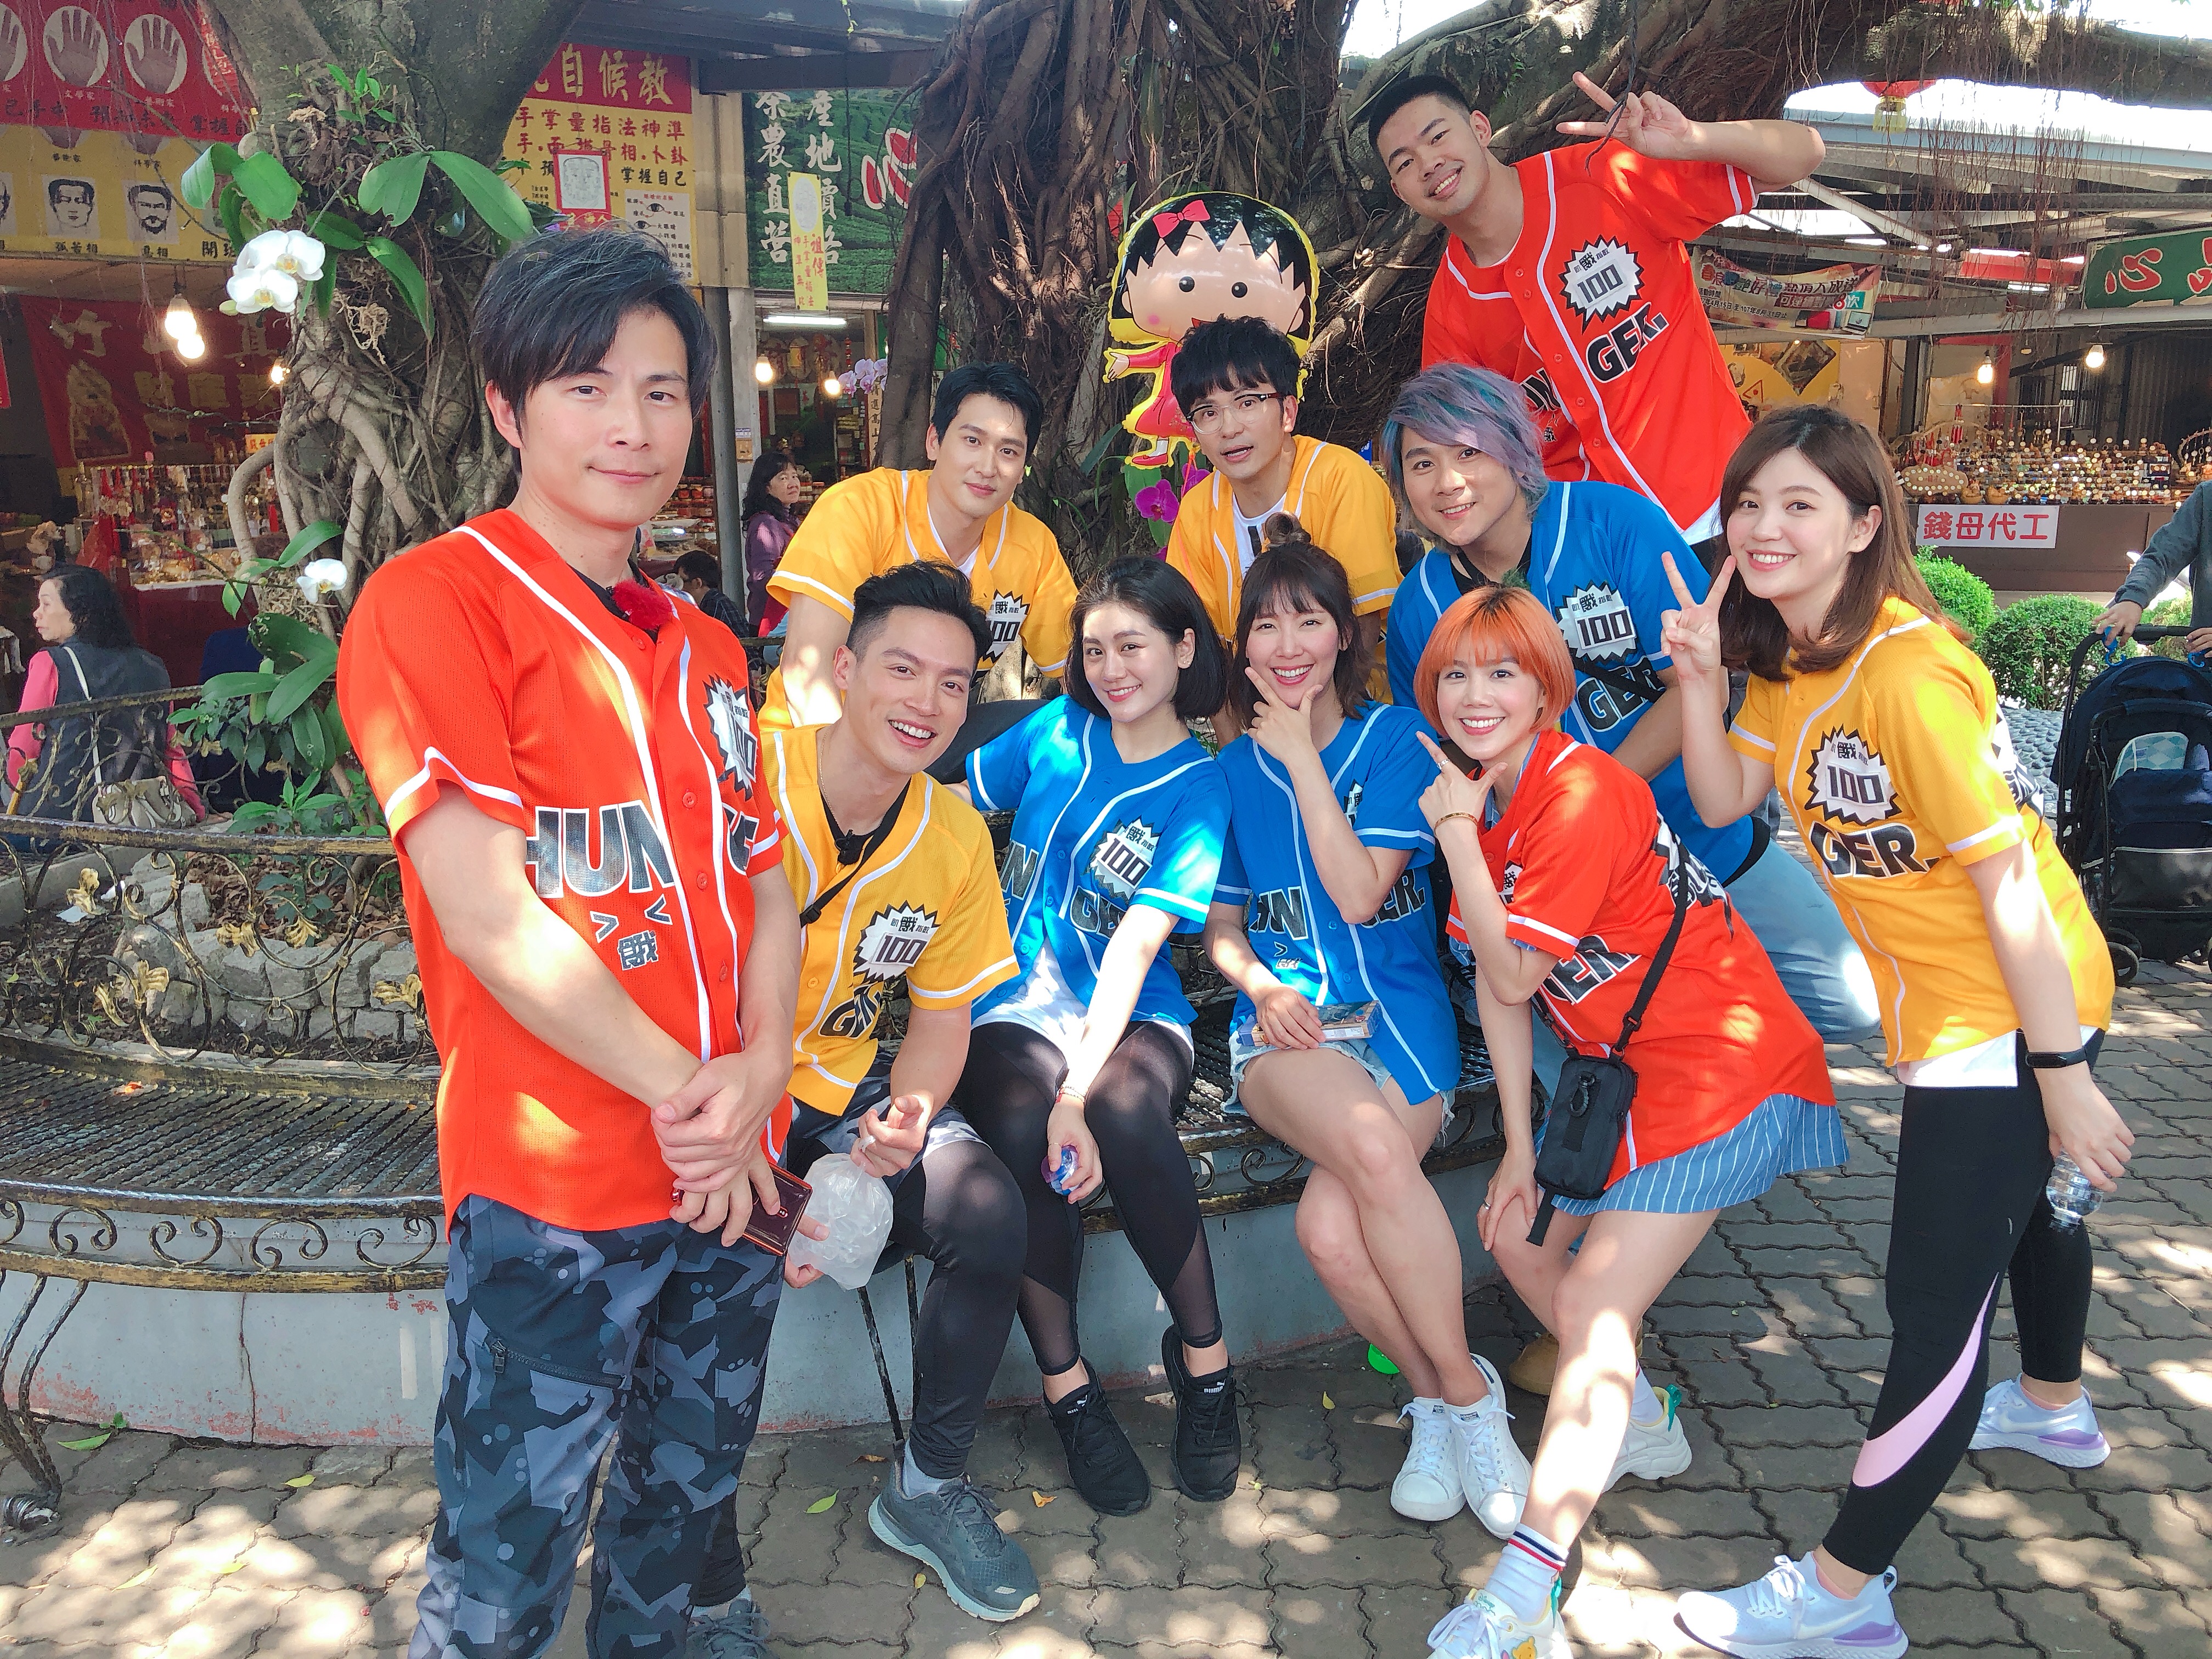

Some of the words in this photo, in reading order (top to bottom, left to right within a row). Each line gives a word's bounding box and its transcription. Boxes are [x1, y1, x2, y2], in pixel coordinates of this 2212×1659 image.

[534, 42, 674, 106] 自候教
[516, 106, 685, 142] 手掌量指法神準
[621, 166, 687, 187] 掌握自己
[1577, 263, 1624, 303] 100
[1923, 511, 2049, 540] 錢母代工
[1577, 608, 1633, 647] 100
[1827, 765, 1885, 804] 100
[1101, 837, 1151, 887] 100
[875, 934, 928, 964] 100
